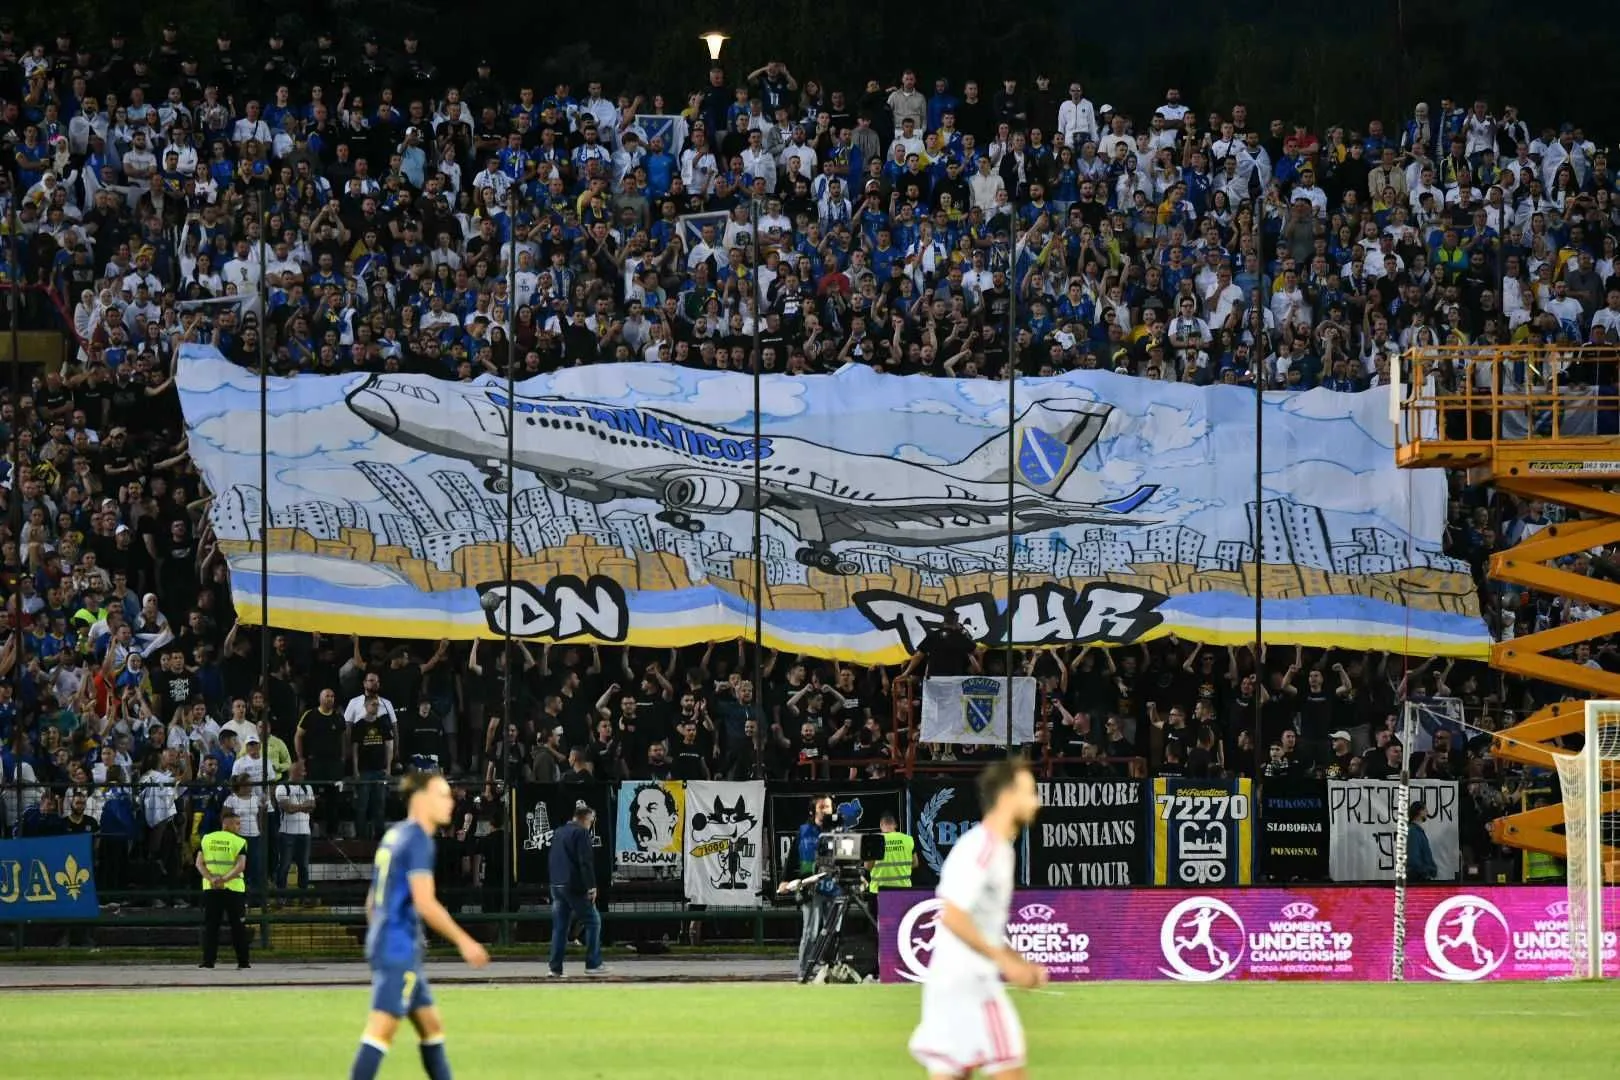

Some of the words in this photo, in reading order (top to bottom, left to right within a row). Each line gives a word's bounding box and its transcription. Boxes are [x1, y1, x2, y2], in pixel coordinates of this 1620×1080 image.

[1037, 782, 1140, 807] HARDCORE
[1155, 795, 1248, 820] 72270
[1042, 820, 1135, 848] BOSNIANS
[1266, 822, 1322, 833] SLOBODNA
[1047, 863, 1074, 886] ON
[1078, 861, 1130, 886] TOUR
[1006, 923, 1069, 934] WOMEN'S
[1268, 921, 1332, 932] WOMEN'S
[1249, 932, 1353, 950] UNDER-19
[1250, 950, 1353, 962] CHAMPIONSHIP
